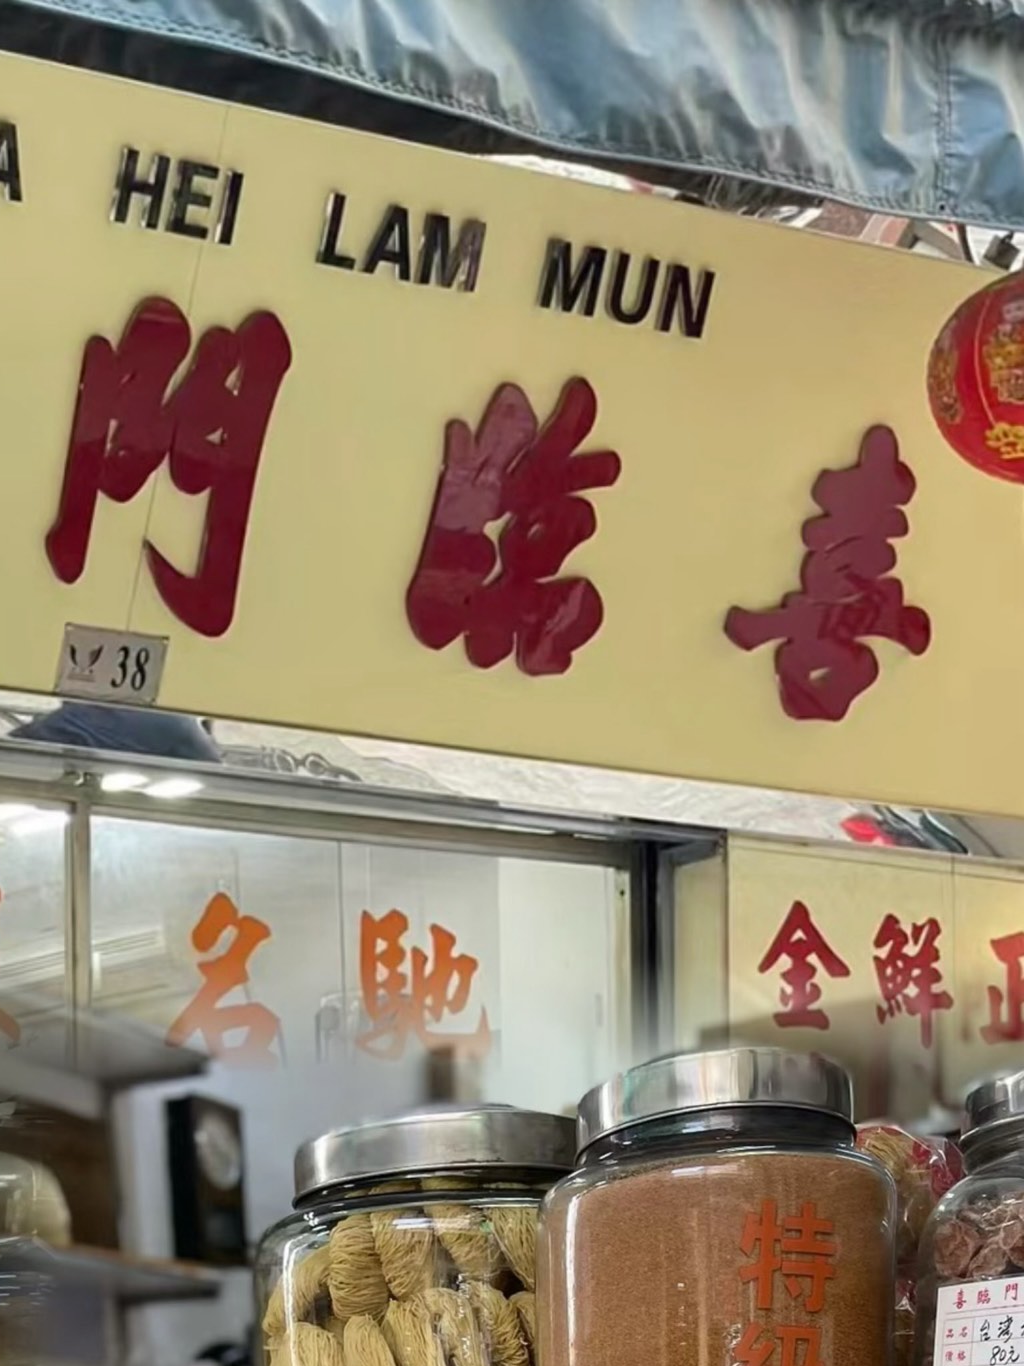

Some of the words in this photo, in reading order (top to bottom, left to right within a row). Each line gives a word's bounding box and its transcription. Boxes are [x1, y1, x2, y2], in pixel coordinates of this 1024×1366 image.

[110, 145, 244, 245] HEI
[315, 191, 486, 293] LAM
[536, 237, 715, 339] MUN
[109, 646, 150, 691] 38
